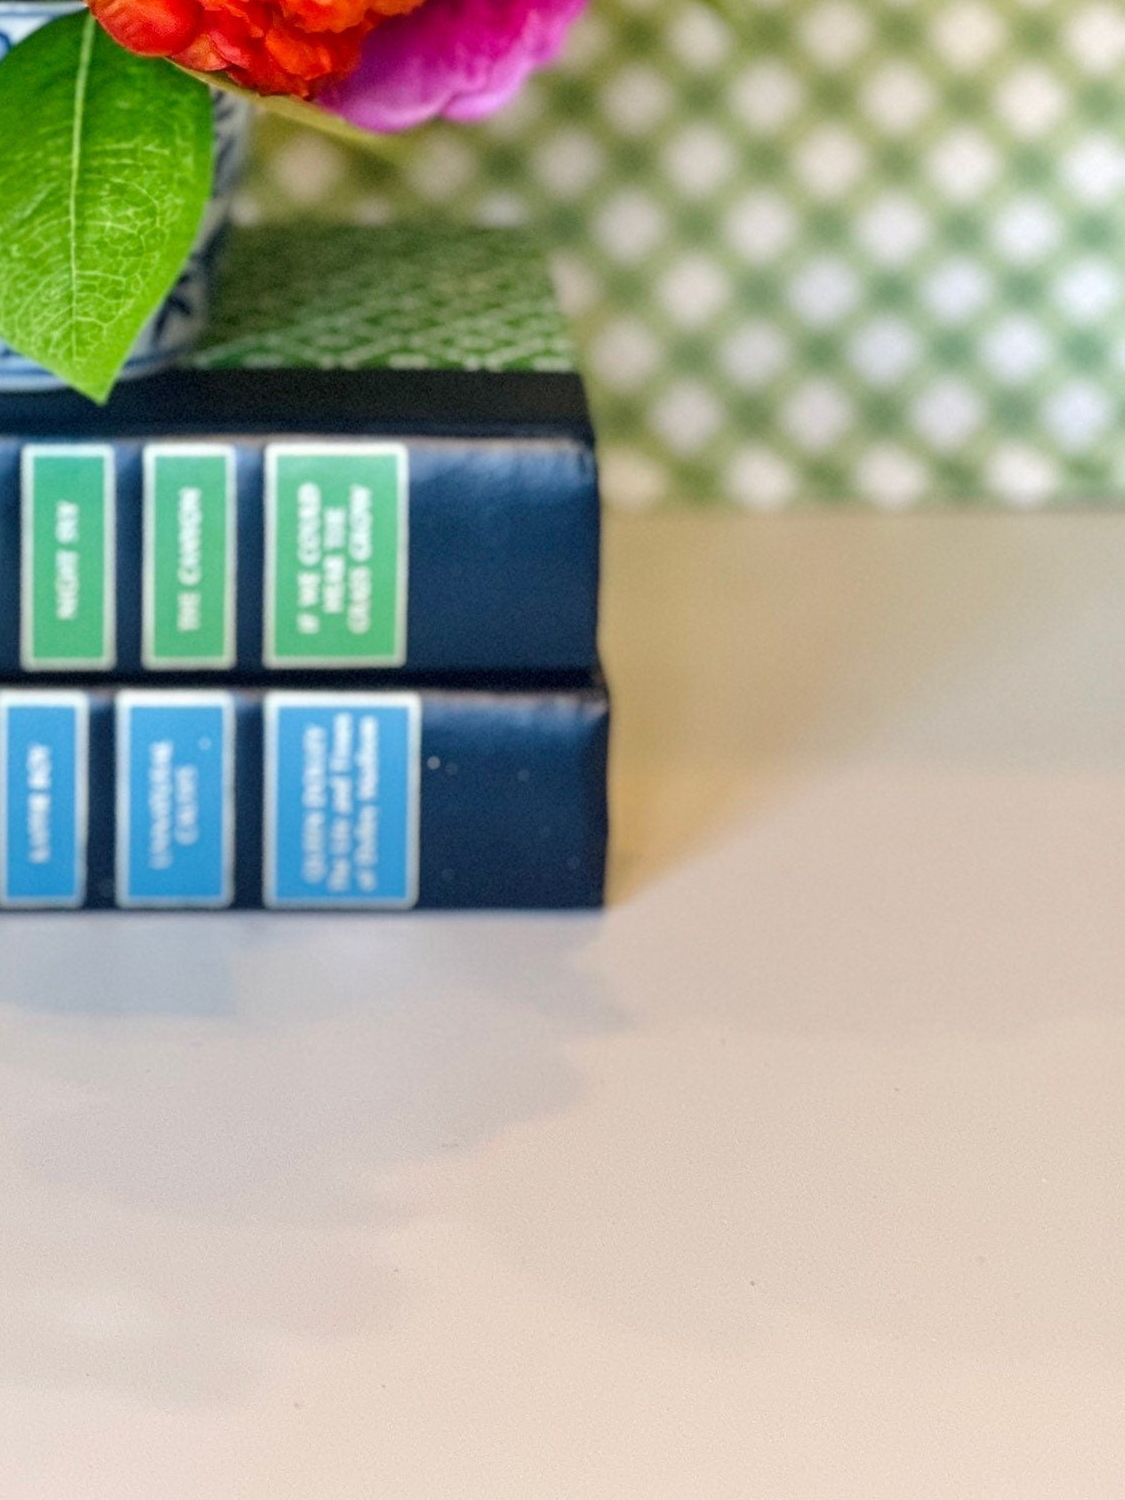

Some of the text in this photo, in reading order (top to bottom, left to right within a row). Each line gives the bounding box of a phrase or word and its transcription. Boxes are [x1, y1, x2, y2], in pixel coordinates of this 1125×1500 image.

[298, 483, 320, 633] IF WE COULD
[324, 556, 344, 612] HEAR
[349, 486, 371, 632] GRASS GROW
